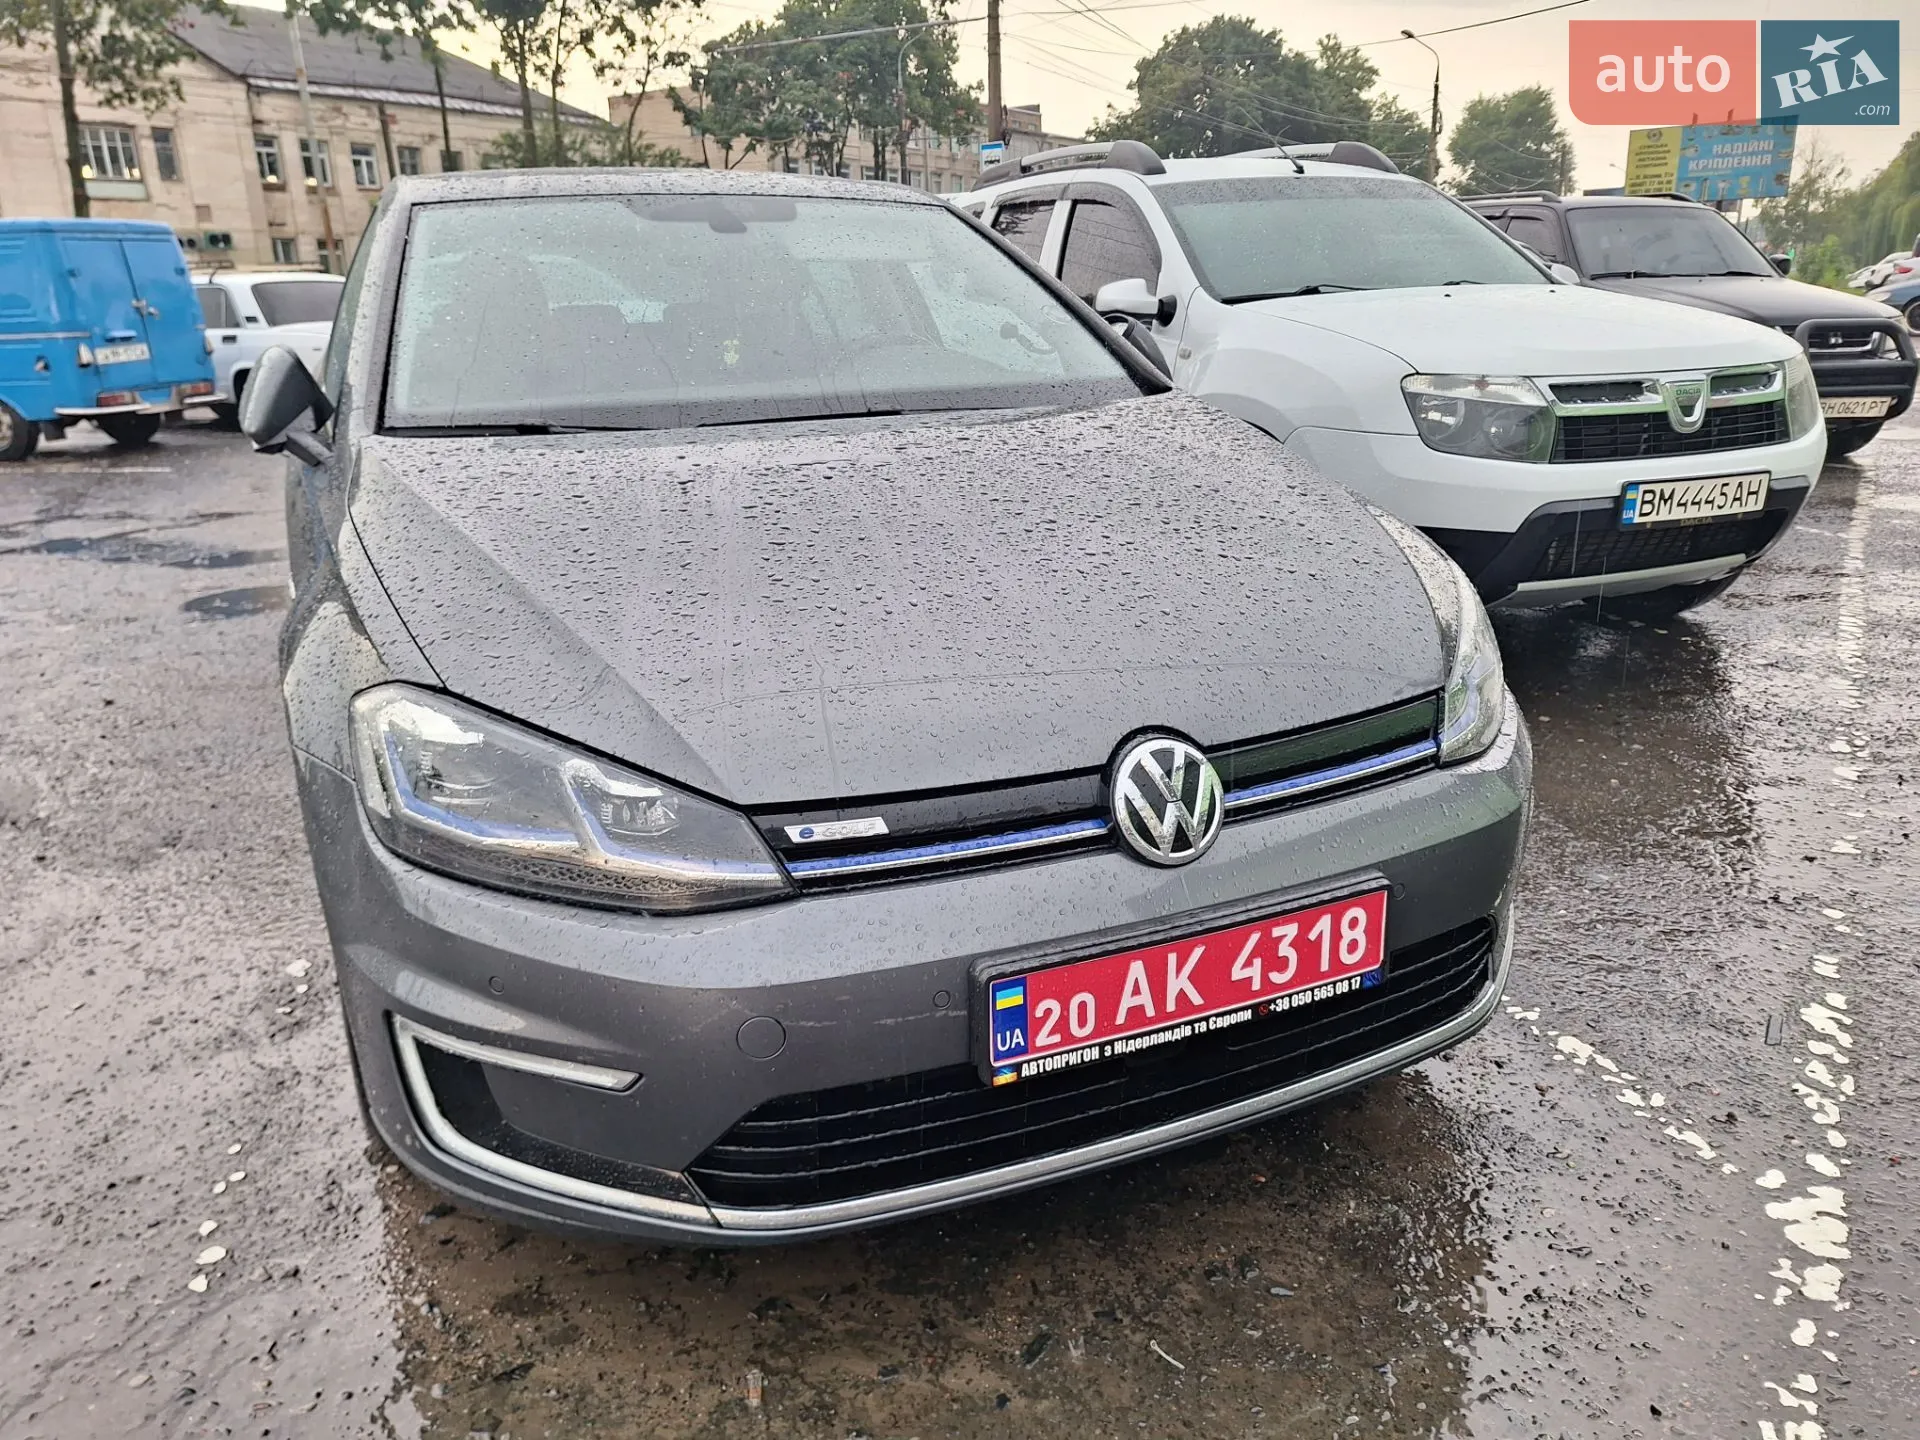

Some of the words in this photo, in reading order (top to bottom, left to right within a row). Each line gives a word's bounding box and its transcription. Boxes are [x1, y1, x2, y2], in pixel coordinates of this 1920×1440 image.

[1712, 139, 1775, 155] НАДІЙНІ
[1688, 153, 1772, 171] КРІПЛЕННЯ
[1675, 387, 1701, 396] DACIA
[1638, 479, 1763, 517] BM4445AH
[1034, 992, 1097, 1048] 20
[1114, 945, 1205, 1026] AK
[1230, 907, 1368, 992] 4318
[996, 1027, 1025, 1052] UA
[1021, 1045, 1100, 1078] АВТОПРИГОН
[1114, 1024, 1192, 1055] Нідерландів
[1193, 1020, 1207, 1035] та
[1208, 1008, 1253, 1031] Європи
[1269, 996, 1290, 1013] +38
[1291, 990, 1313, 1008] 050
[1313, 984, 1335, 1002] 565
[1335, 979, 1350, 996] 08
[1350, 976, 1362, 991] 17
